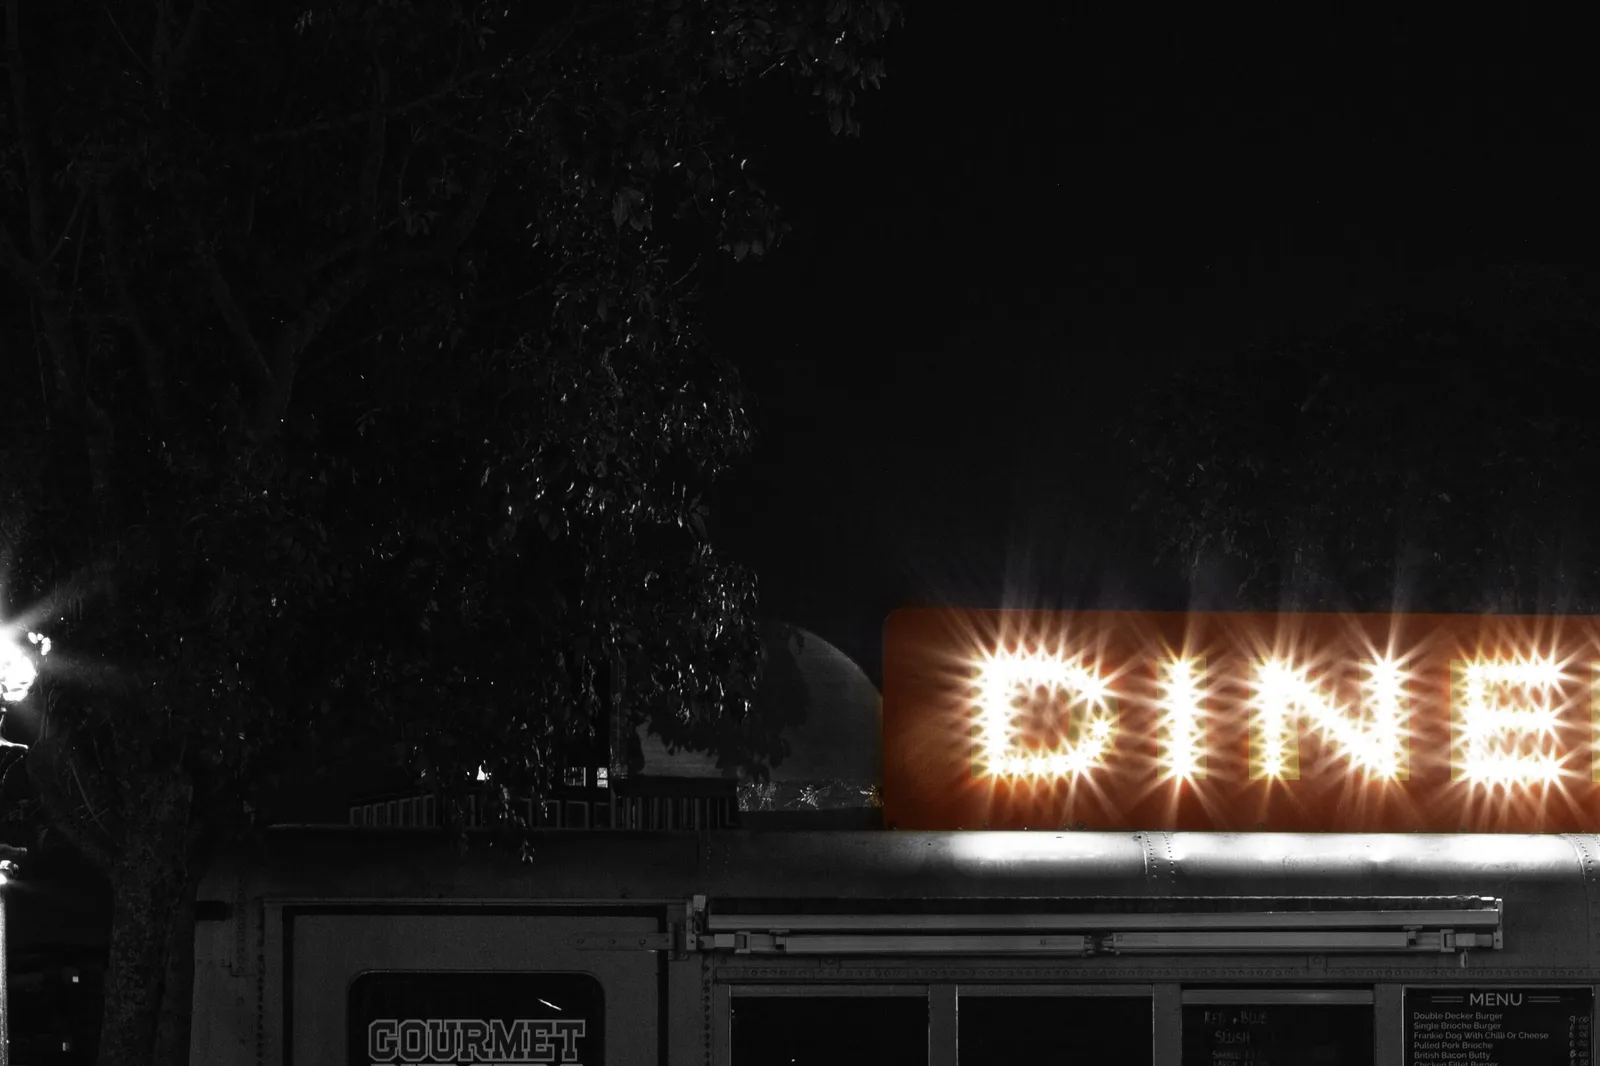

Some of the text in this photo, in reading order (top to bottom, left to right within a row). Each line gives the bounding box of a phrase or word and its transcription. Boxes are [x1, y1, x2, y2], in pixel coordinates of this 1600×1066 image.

[1469, 992, 1523, 1006] MENU
[1413, 1012, 1443, 1020] Double
[1445, 1012, 1473, 1020] Decker
[1475, 1012, 1503, 1021] Burger
[1413, 1022, 1439, 1031] Single
[1441, 1022, 1472, 1030] Brioche
[1474, 1022, 1501, 1031] Burger
[368, 1019, 586, 1062] GOURMET
[1445, 1032, 1462, 1041] Dog
[1413, 1041, 1440, 1049] Pulled
[1441, 1041, 1460, 1049] Pork
[1462, 1041, 1493, 1049] Brioche
[1413, 1051, 1439, 1059] British
[1441, 1051, 1467, 1059] Bacon
[1468, 1051, 1491, 1060] Butty
